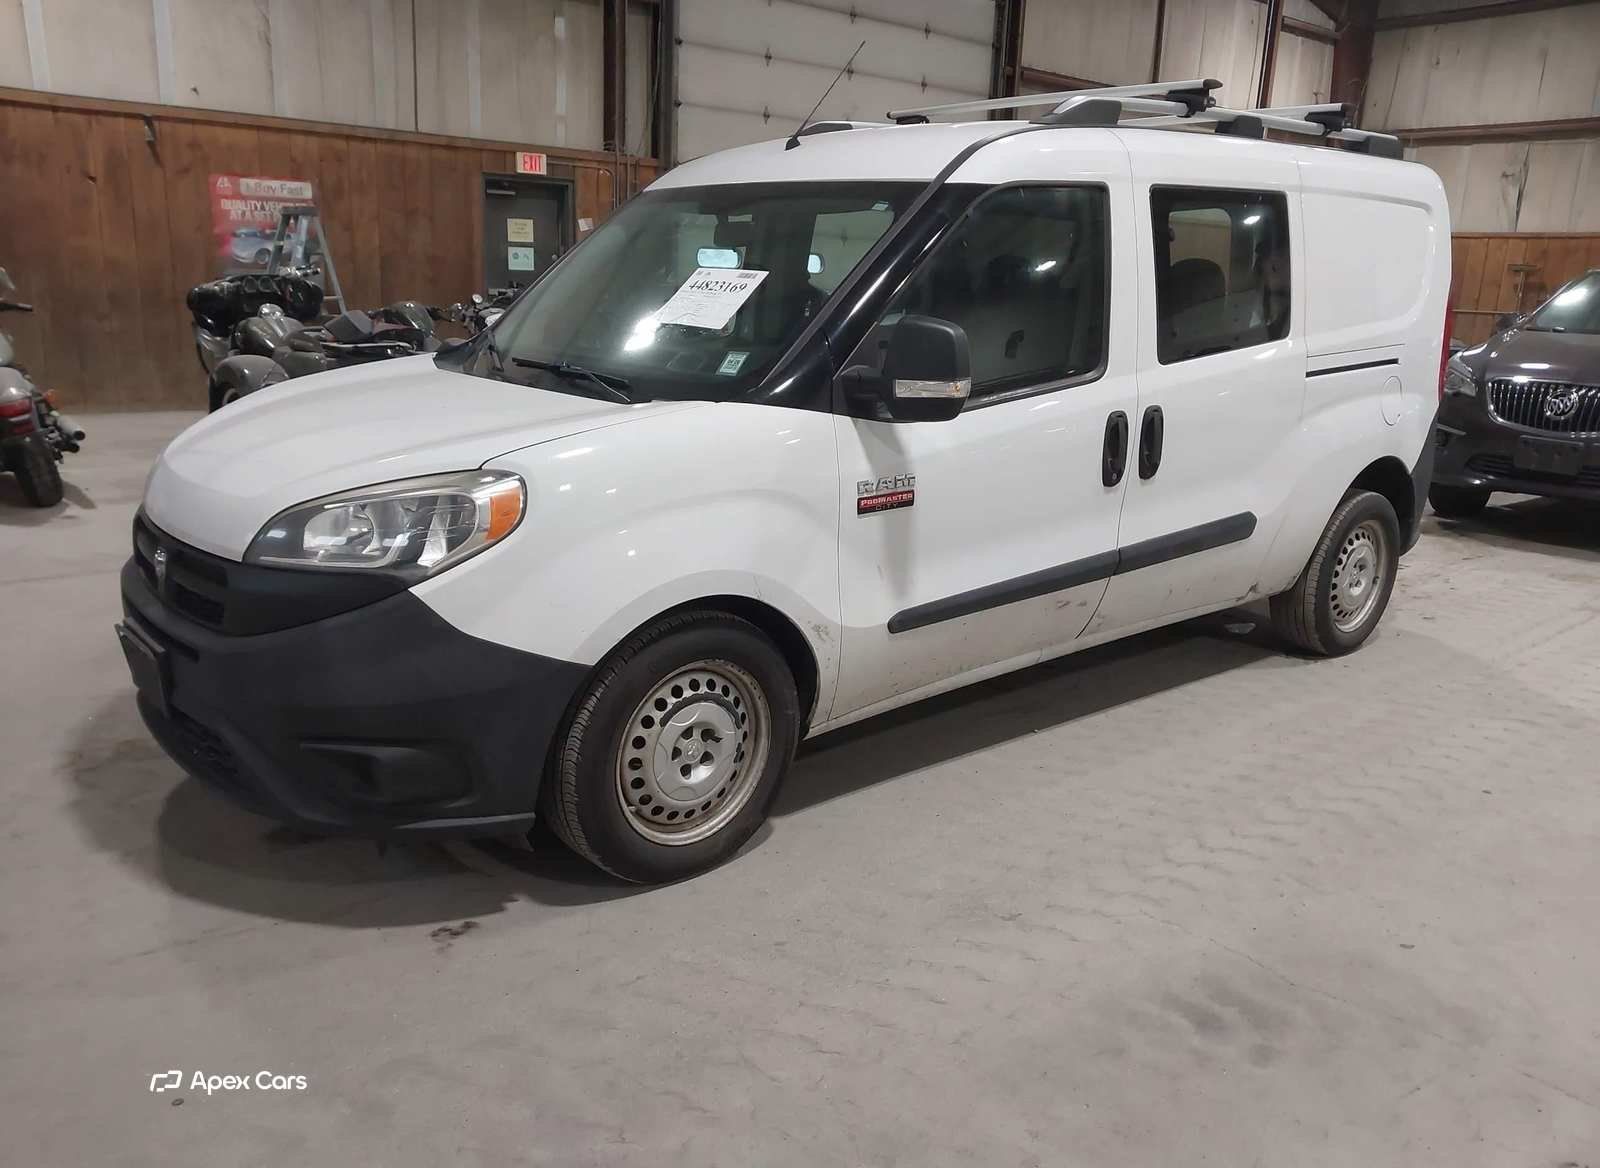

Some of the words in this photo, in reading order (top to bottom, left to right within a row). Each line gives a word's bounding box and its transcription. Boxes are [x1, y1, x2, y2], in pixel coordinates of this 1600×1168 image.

[522, 153, 542, 172] EXIT
[280, 184, 305, 195] Fast
[220, 199, 263, 211] QUALITY
[230, 210, 243, 220] AT
[244, 211, 252, 221] A
[253, 211, 272, 222] SET
[688, 279, 748, 294] 44823169
[857, 473, 916, 496] RAM
[875, 503, 898, 511] CITY
